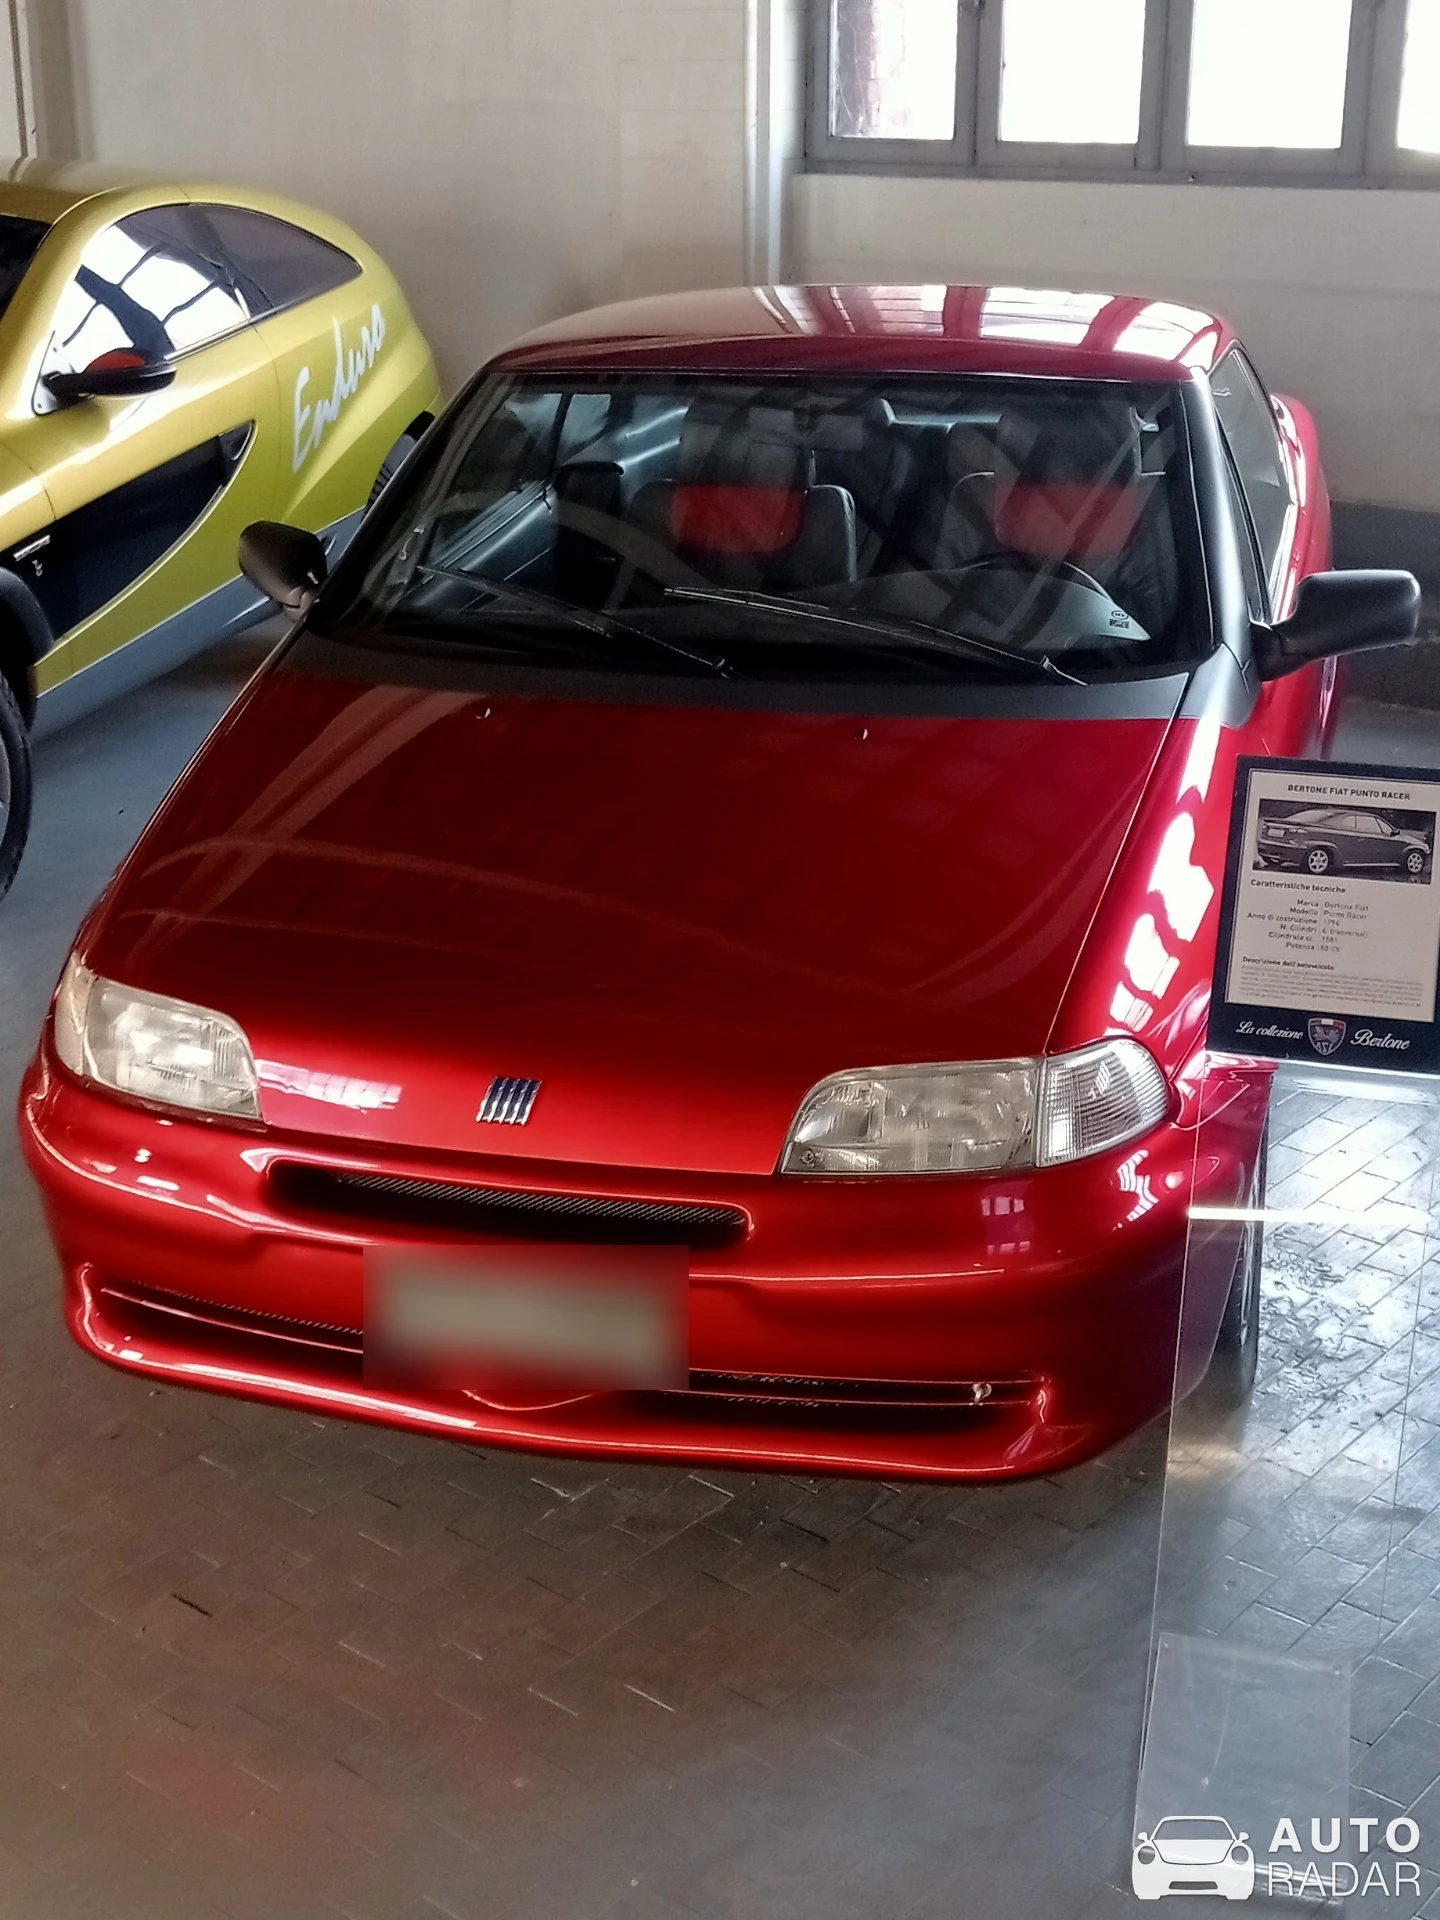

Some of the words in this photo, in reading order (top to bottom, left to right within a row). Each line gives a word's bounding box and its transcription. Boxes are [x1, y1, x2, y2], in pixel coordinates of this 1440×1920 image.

[1287, 784, 1327, 795] BERTONE
[1329, 787, 1348, 796] FIAT
[1350, 789, 1379, 798] PUNTO
[1381, 791, 1410, 800] RACER
[1250, 879, 1310, 891] Caratteristiche
[1312, 884, 1346, 893] tecniche
[1296, 899, 1319, 907] Marca
[1289, 907, 1318, 916] Modello
[1247, 912, 1266, 920] Anno
[1276, 915, 1317, 924] costruzione
[1286, 941, 1315, 950] Potenza
[1242, 956, 1281, 966] Descrizione
[1235, 1020, 1255, 1034] La
[1255, 1023, 1304, 1040] collezione
[1350, 1028, 1411, 1050] Bertone
